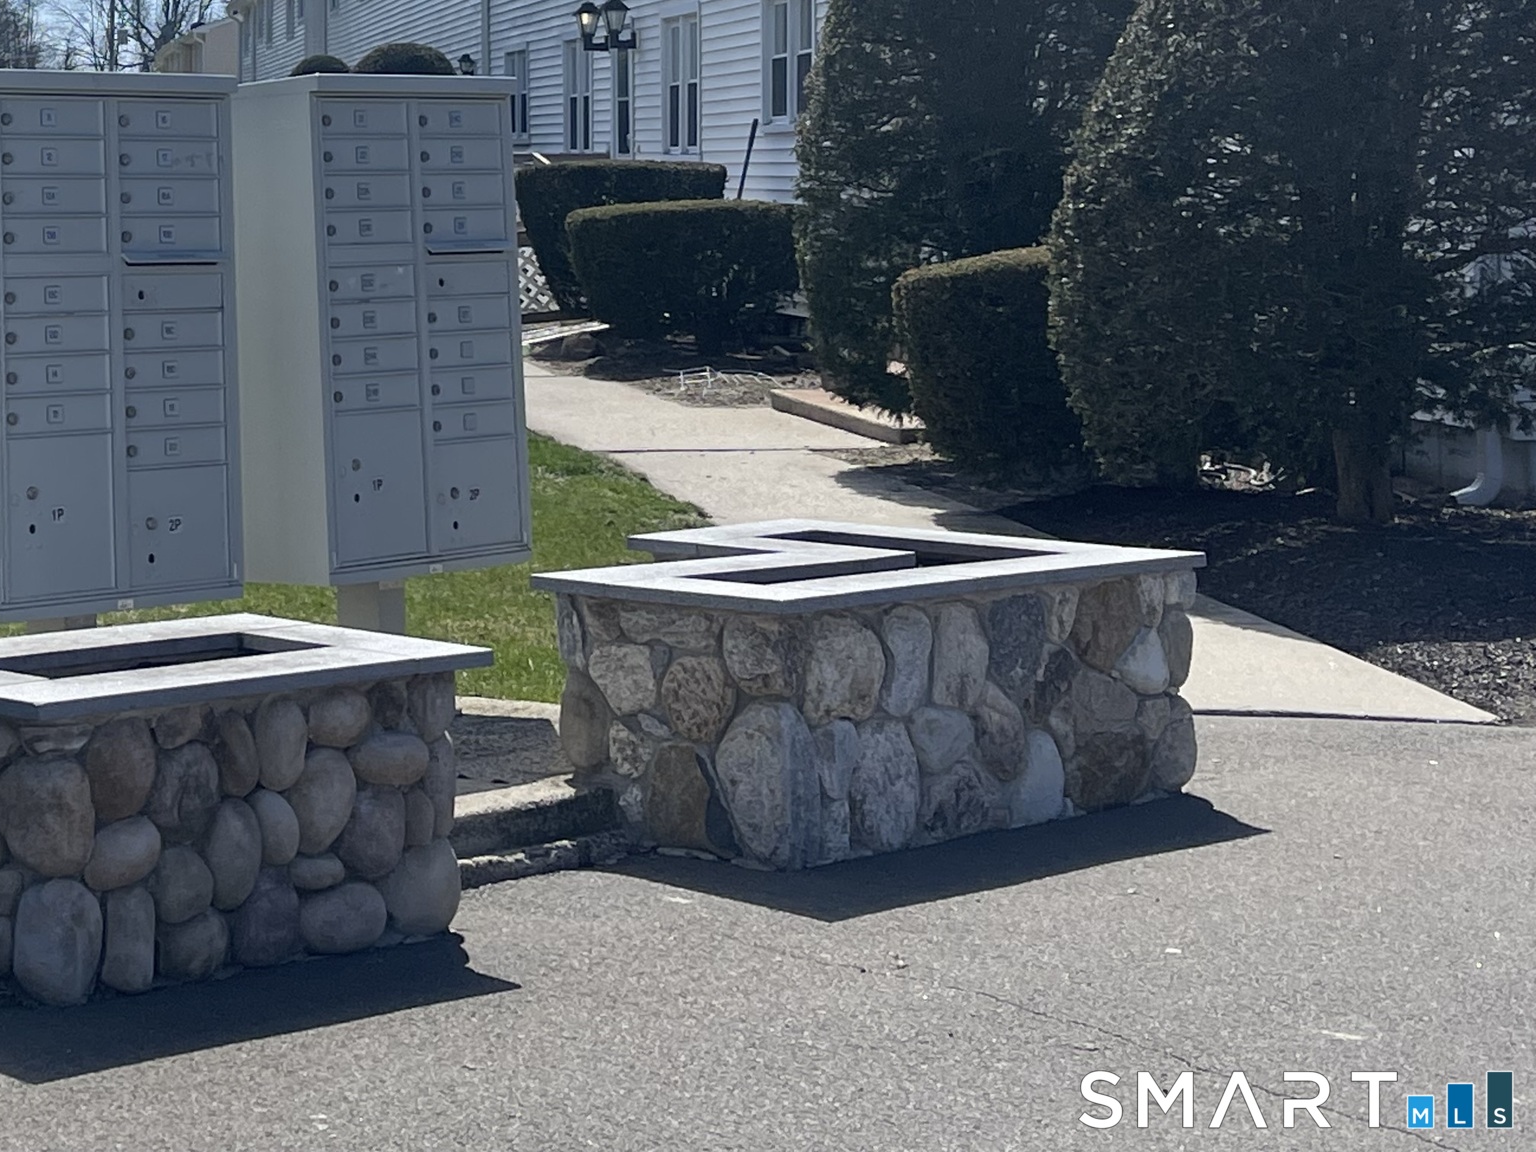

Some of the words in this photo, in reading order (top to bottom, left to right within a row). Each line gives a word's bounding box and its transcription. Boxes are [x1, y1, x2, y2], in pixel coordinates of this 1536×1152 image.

[372, 478, 383, 491] 1P
[469, 488, 480, 501] 2P
[52, 508, 64, 521] 1P
[169, 518, 181, 532] 2P
